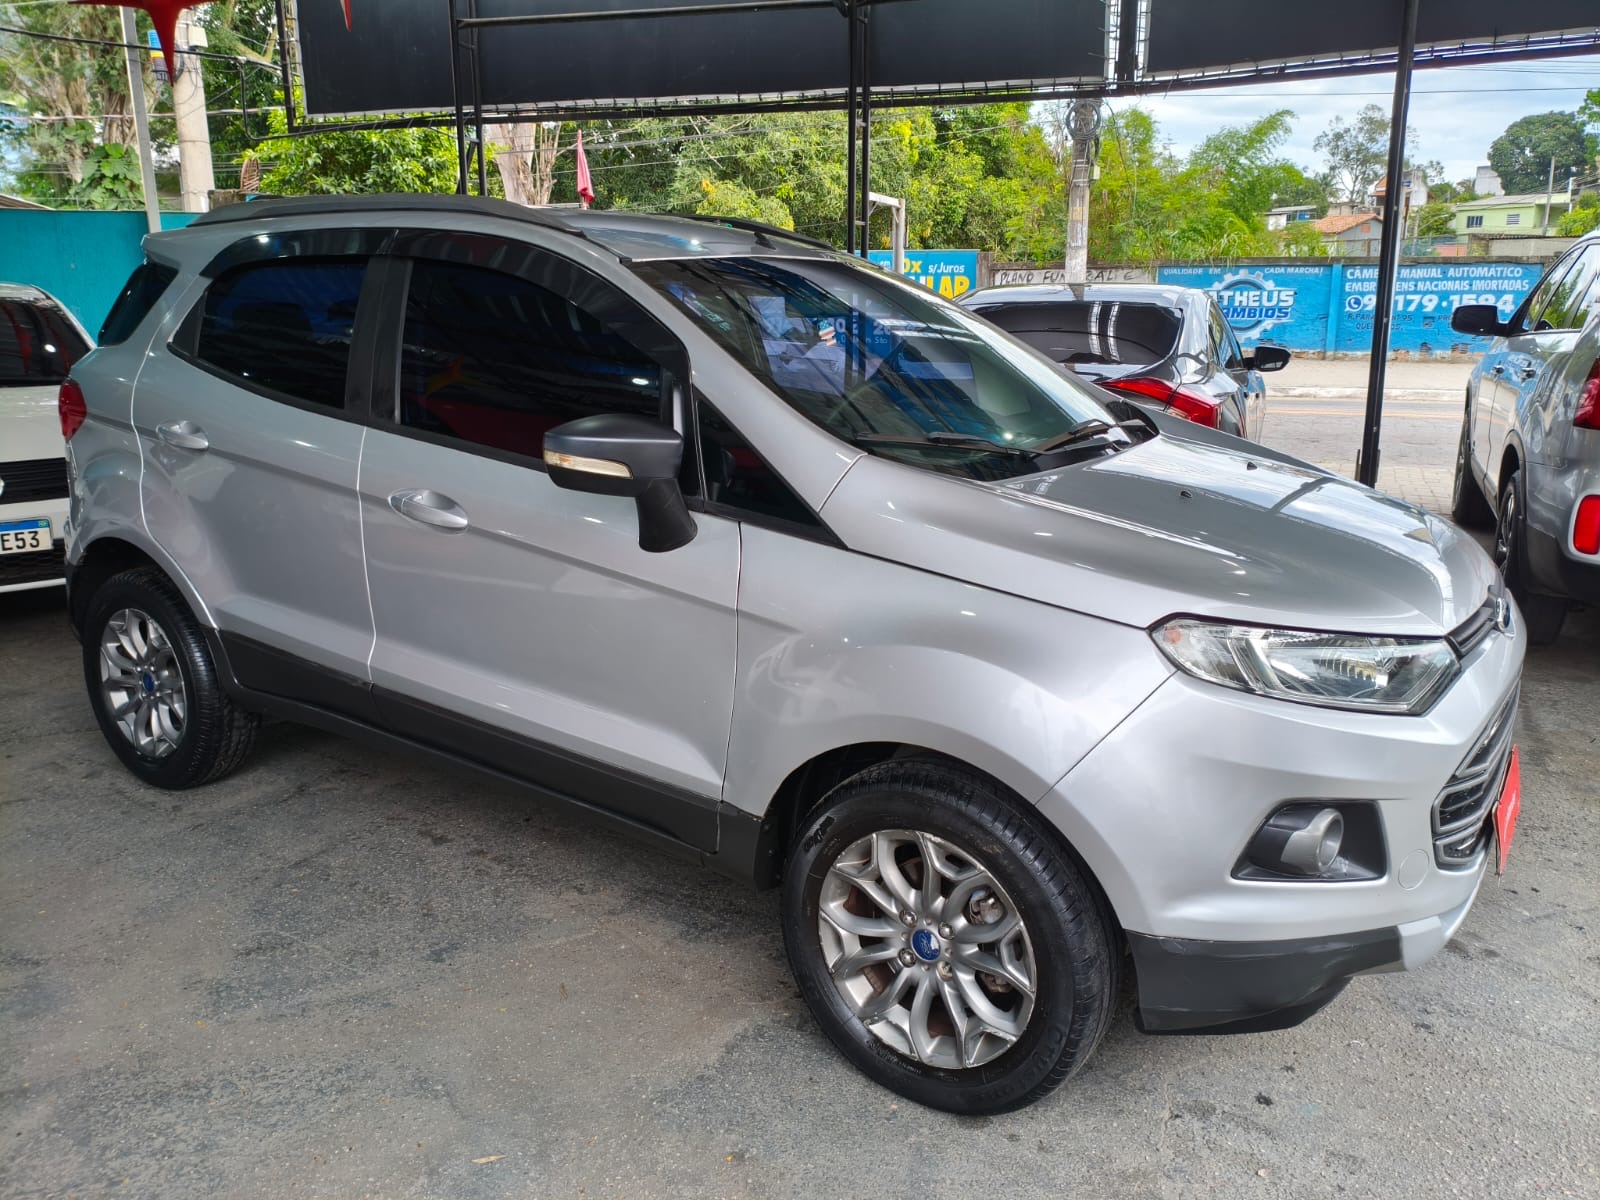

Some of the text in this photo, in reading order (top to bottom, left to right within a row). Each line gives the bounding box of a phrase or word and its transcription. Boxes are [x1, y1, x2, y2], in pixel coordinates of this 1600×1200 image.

[928, 261, 965, 274] s/Juros
[1163, 268, 1204, 276] QUALIDADE
[1264, 266, 1286, 275] CADA
[1400, 268, 1443, 278] MANUAL
[1447, 264, 1523, 278] AUTOMÁTICO
[999, 271, 1034, 286] PLANO
[1417, 280, 1470, 292] NACIONAIS
[1472, 279, 1529, 291] IMORTADAS
[1208, 290, 1295, 307] ATHEUS
[1222, 307, 1291, 319] AMBIOS
[1, 531, 39, 551] E53
